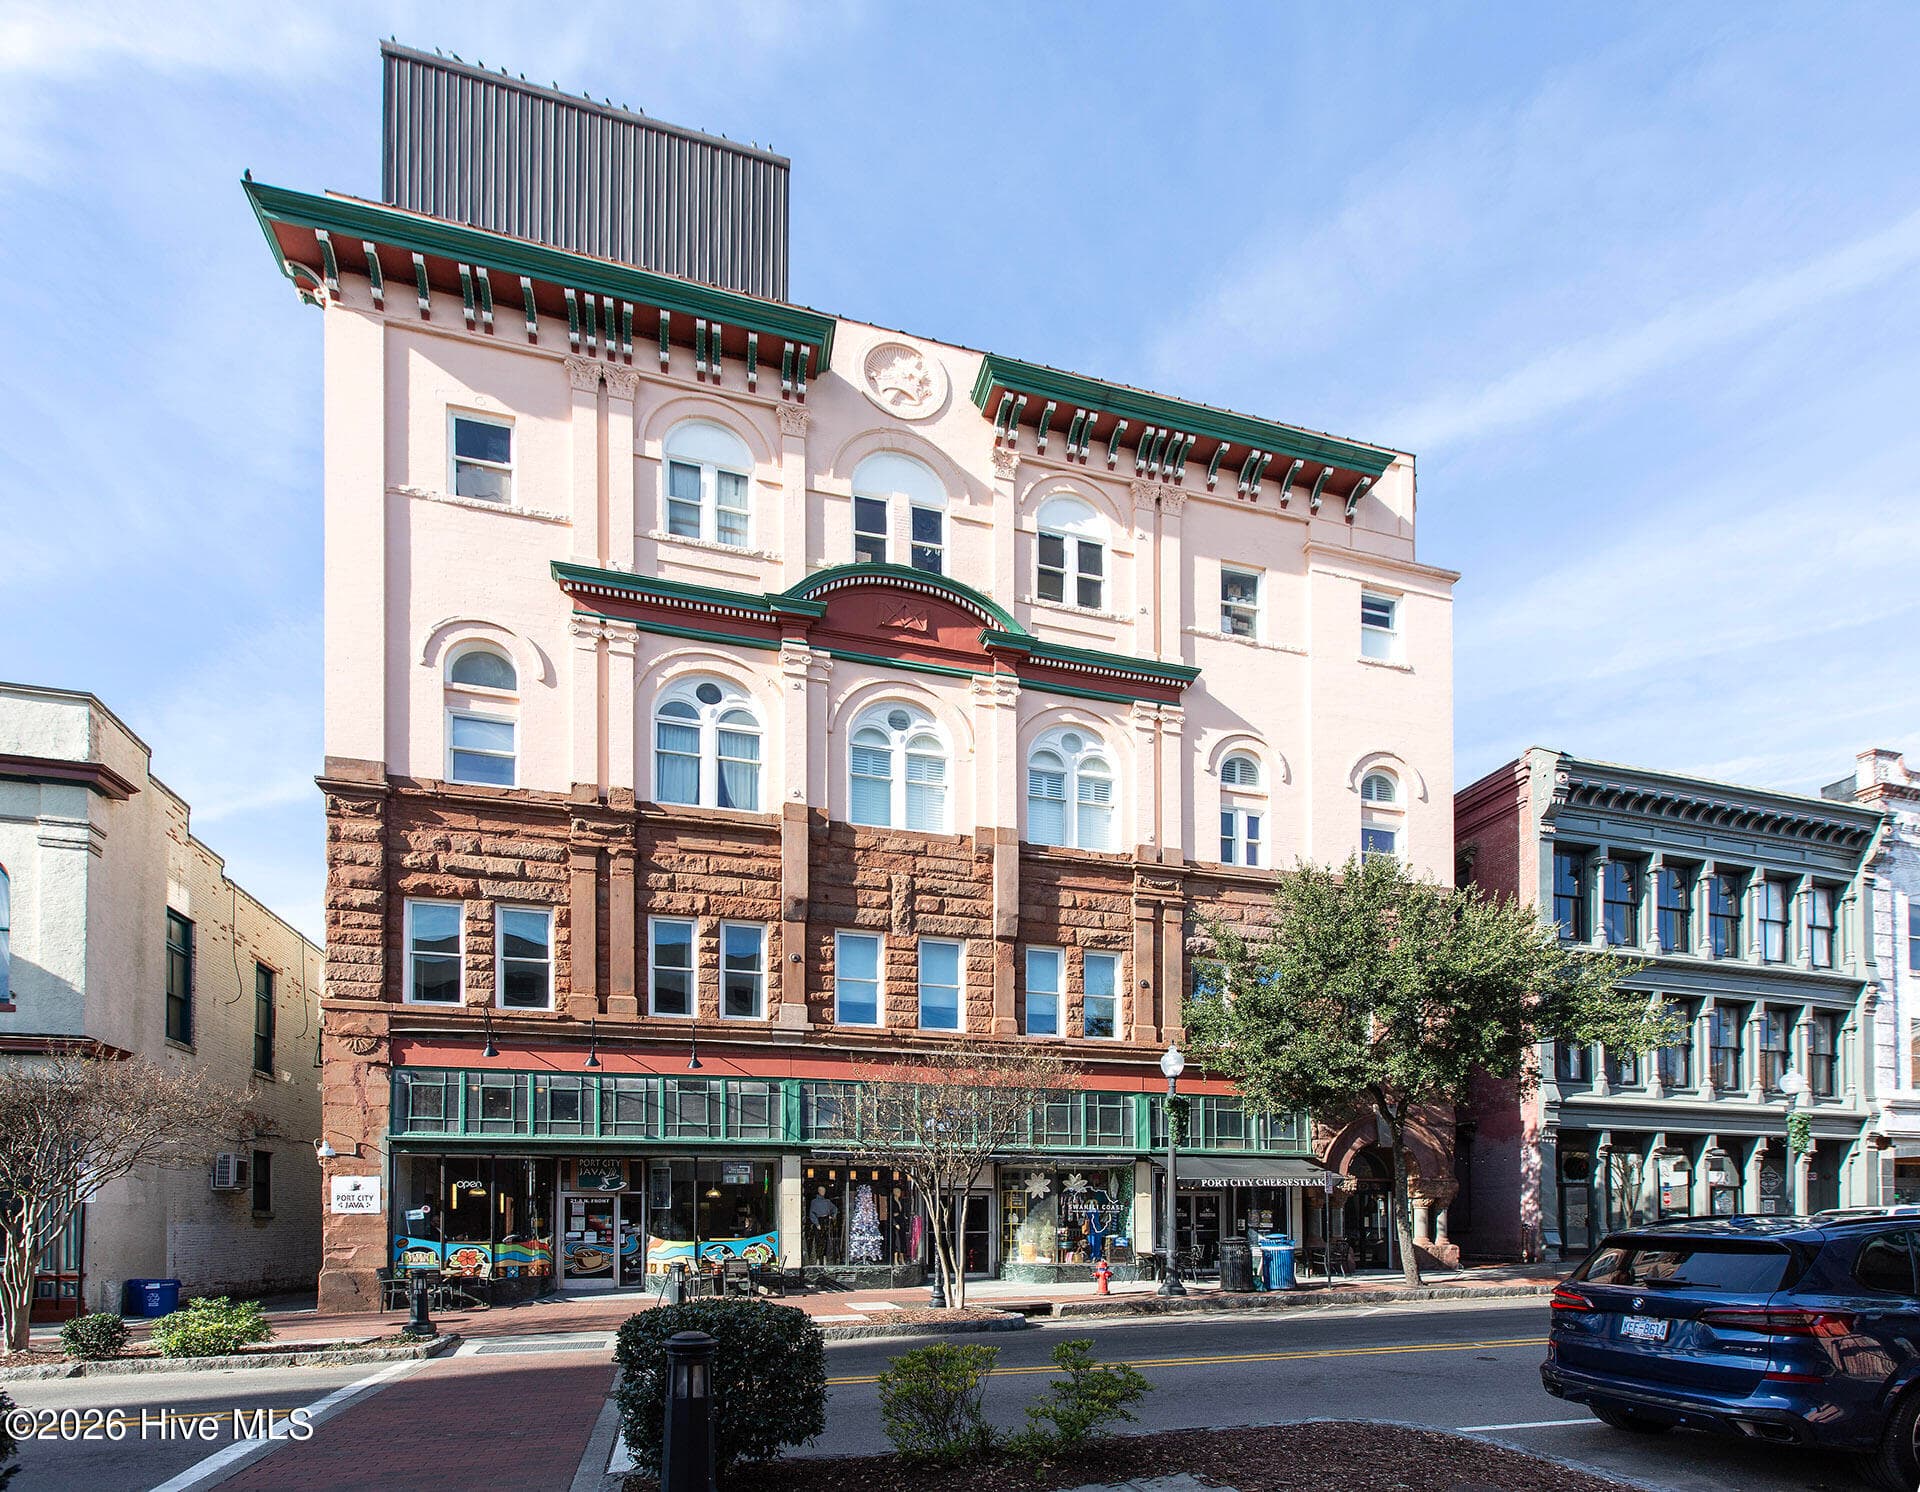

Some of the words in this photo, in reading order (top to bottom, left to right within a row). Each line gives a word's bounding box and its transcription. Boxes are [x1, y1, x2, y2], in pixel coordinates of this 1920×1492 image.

[579, 1158, 600, 1167] PORT
[602, 1159, 621, 1167] CITY
[579, 1168, 606, 1176] JAVA
[1201, 1178, 1229, 1187] PORT
[1230, 1178, 1255, 1187] CITY
[1256, 1177, 1325, 1187] CHEESESTEAK
[336, 1194, 355, 1202] PORT
[357, 1194, 374, 1202] CITY
